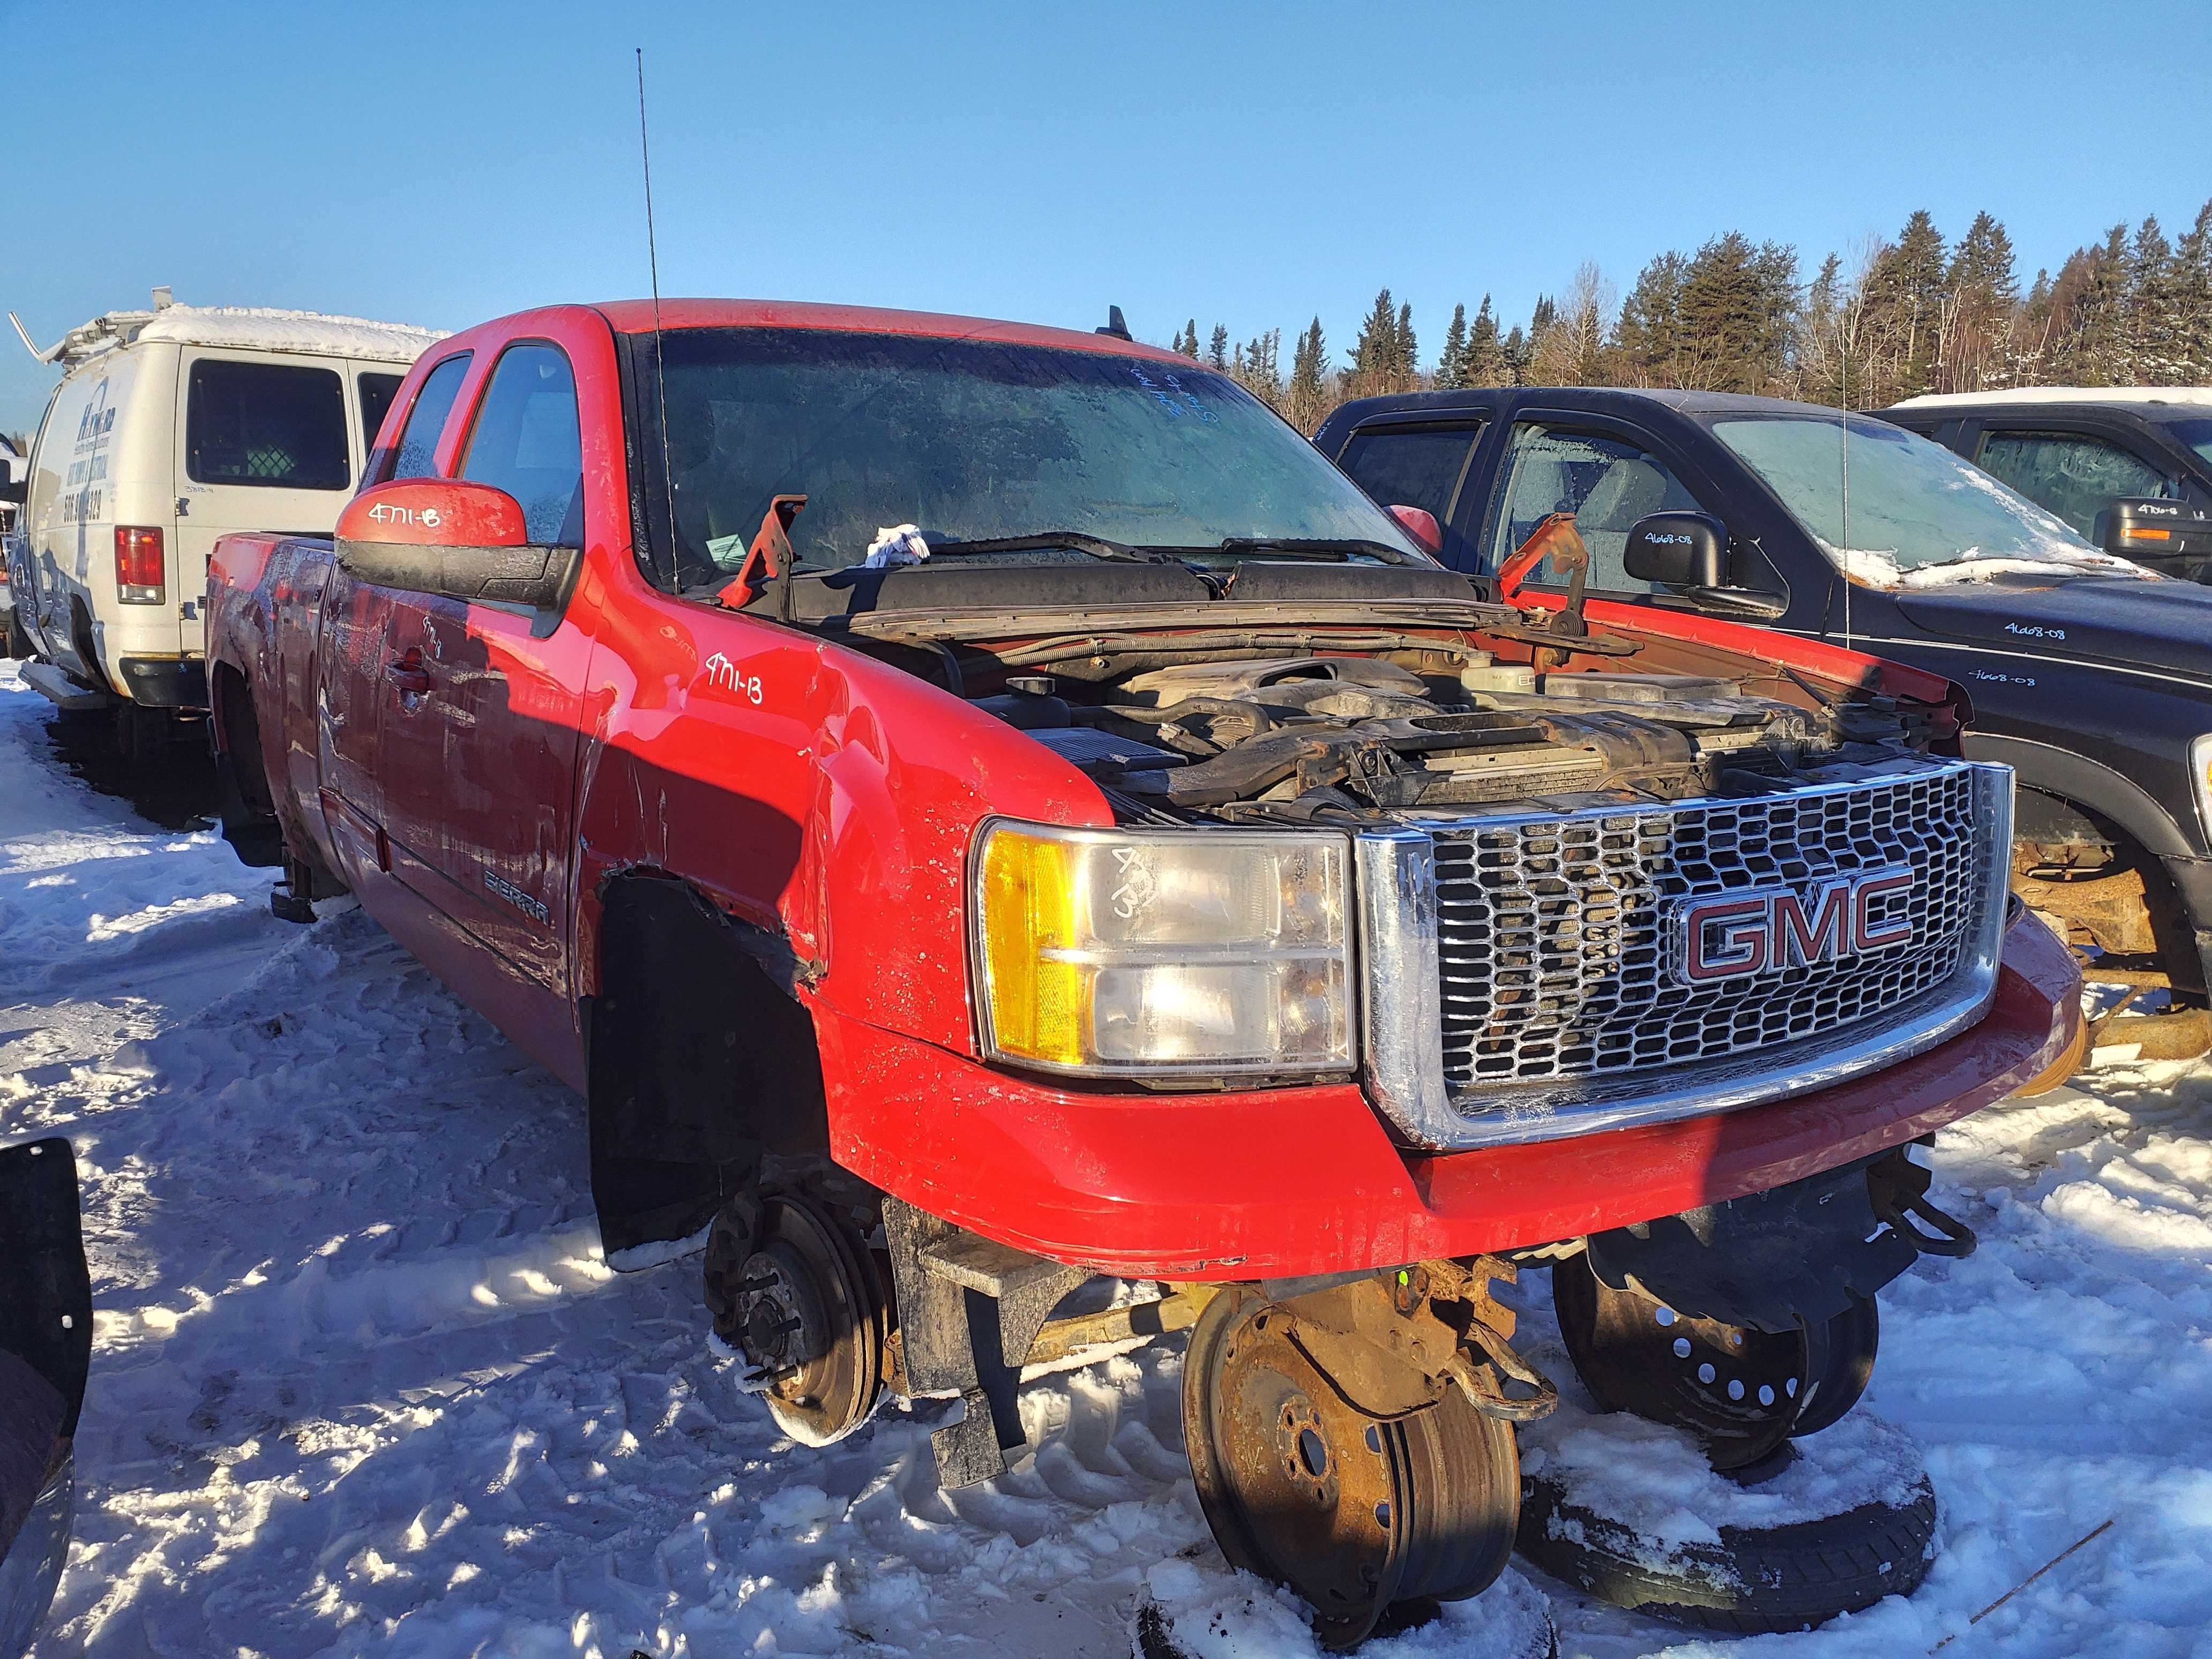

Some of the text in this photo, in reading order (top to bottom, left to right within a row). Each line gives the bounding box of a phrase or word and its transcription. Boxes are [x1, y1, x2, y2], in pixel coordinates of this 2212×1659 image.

[1645, 532, 1693, 544] 4668-08
[1968, 669, 2035, 686] 4668-08
[484, 870, 550, 926] SIERRA
[1677, 864, 1915, 985] GMC
